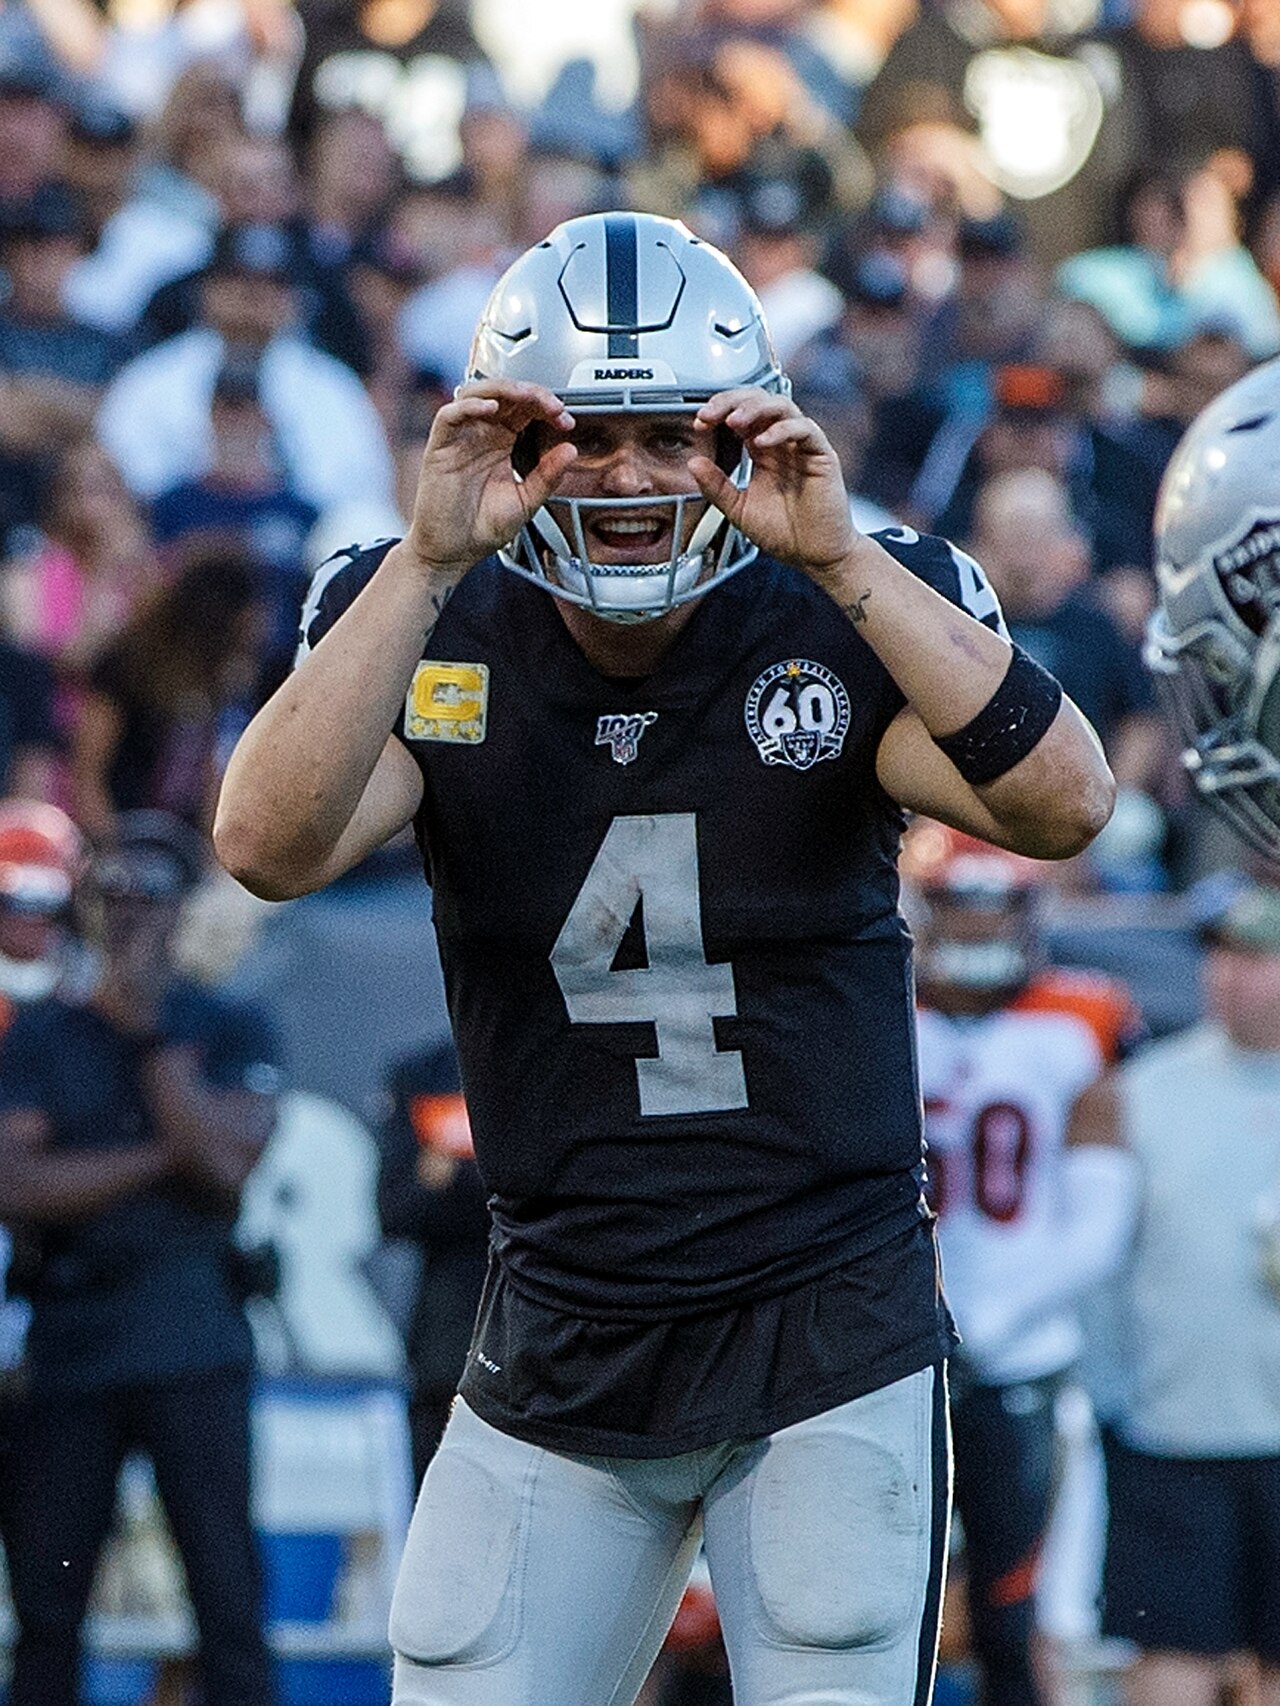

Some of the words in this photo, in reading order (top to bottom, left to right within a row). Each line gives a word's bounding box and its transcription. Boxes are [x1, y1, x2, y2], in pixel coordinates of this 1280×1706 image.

[594, 368, 654, 380] RAIDERS
[414, 666, 483, 721] C
[762, 684, 835, 739] 60
[549, 813, 749, 1116] 4
